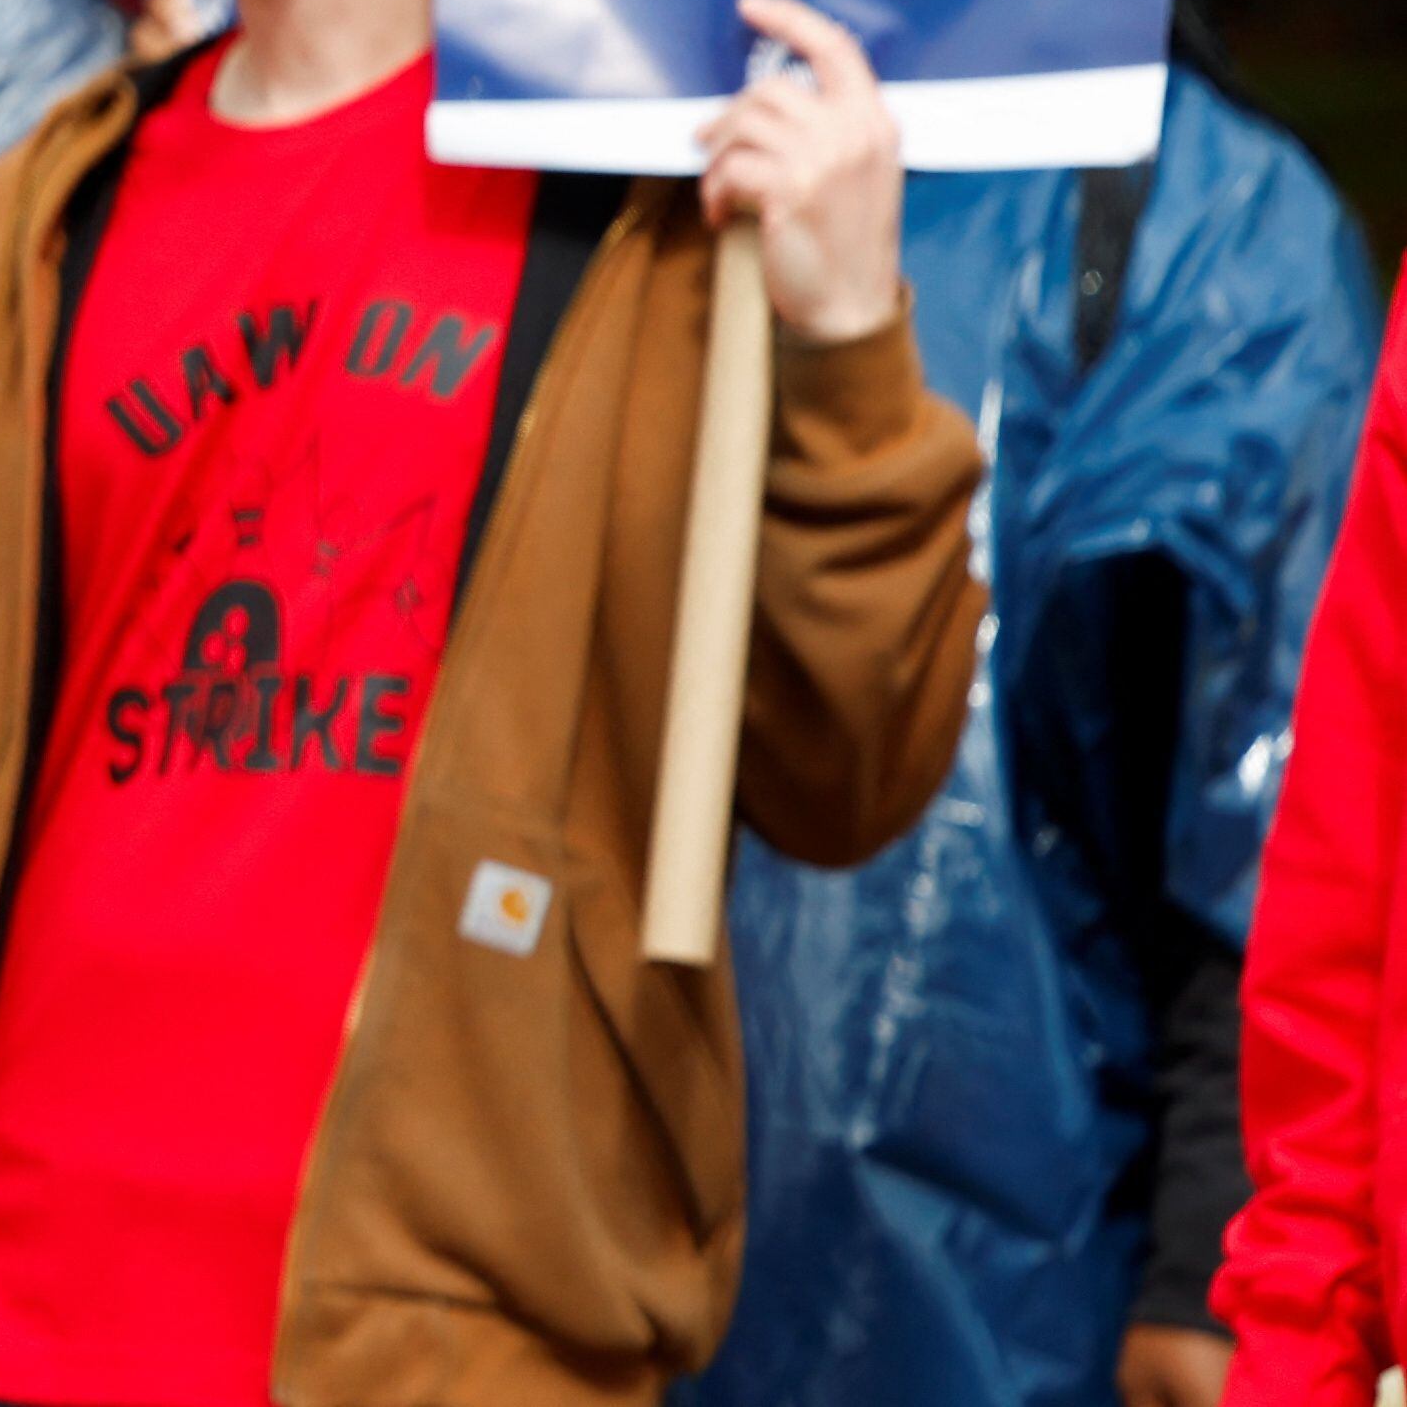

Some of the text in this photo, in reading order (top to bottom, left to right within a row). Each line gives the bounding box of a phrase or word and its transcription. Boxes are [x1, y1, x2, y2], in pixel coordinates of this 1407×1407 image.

[106, 299, 494, 457] UAW ON
[106, 675, 411, 783] STRIKE
